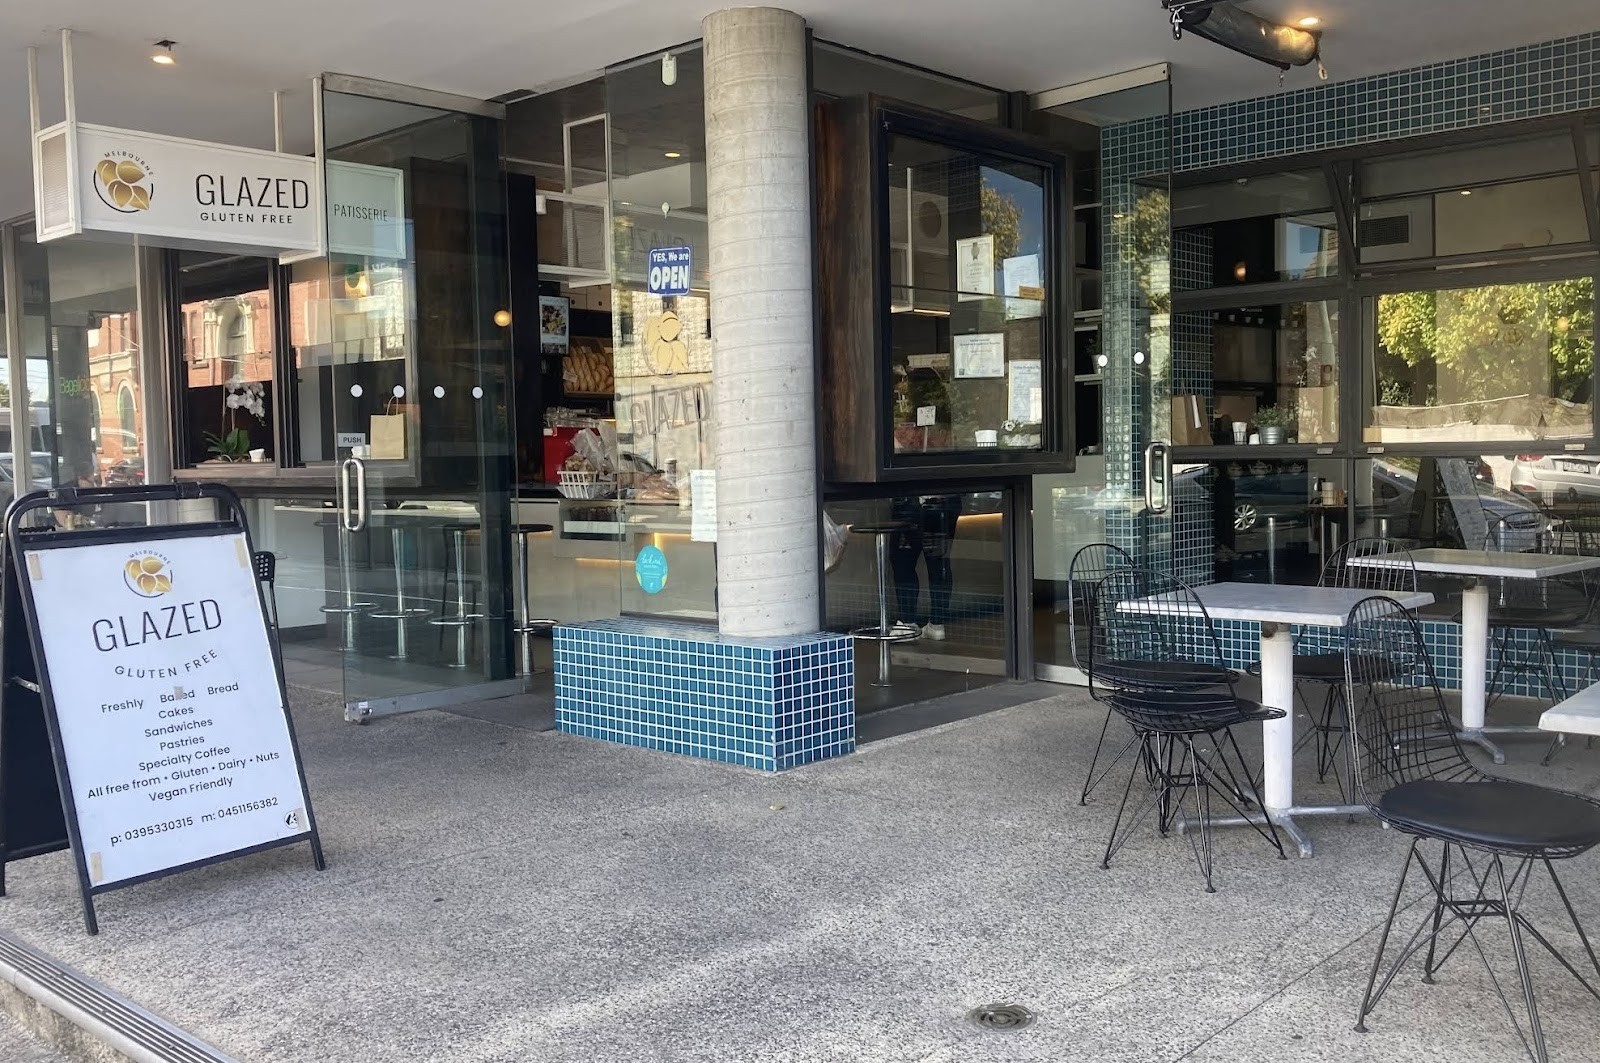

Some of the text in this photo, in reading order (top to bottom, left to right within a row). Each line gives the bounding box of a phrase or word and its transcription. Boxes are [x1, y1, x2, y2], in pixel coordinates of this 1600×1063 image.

[104, 151, 154, 176] MELBOURNE
[195, 174, 309, 209] GLAZED
[200, 212, 293, 224] GLUTEN FREE
[333, 203, 389, 222] PATISSERIE
[652, 252, 689, 263] YES, We are
[650, 265, 689, 290] OPEN
[630, 383, 711, 439] GLAZED
[343, 436, 362, 444] PUSH
[92, 599, 222, 652] GLAZED
[114, 649, 218, 679] GLUTEN FREE
[101, 682, 239, 713] Freshly Baed Bread
[158, 705, 194, 719] Cakes
[144, 718, 213, 738] Sandwiches
[159, 735, 205, 751] Pastries
[138, 745, 231, 773] Specialty Coffee
[87, 751, 280, 799] All free from Gluten Dairy Nuts
[148, 776, 233, 802] Vegan Friendly
[110, 796, 279, 847] p: 0395330315 m: 0451156382
